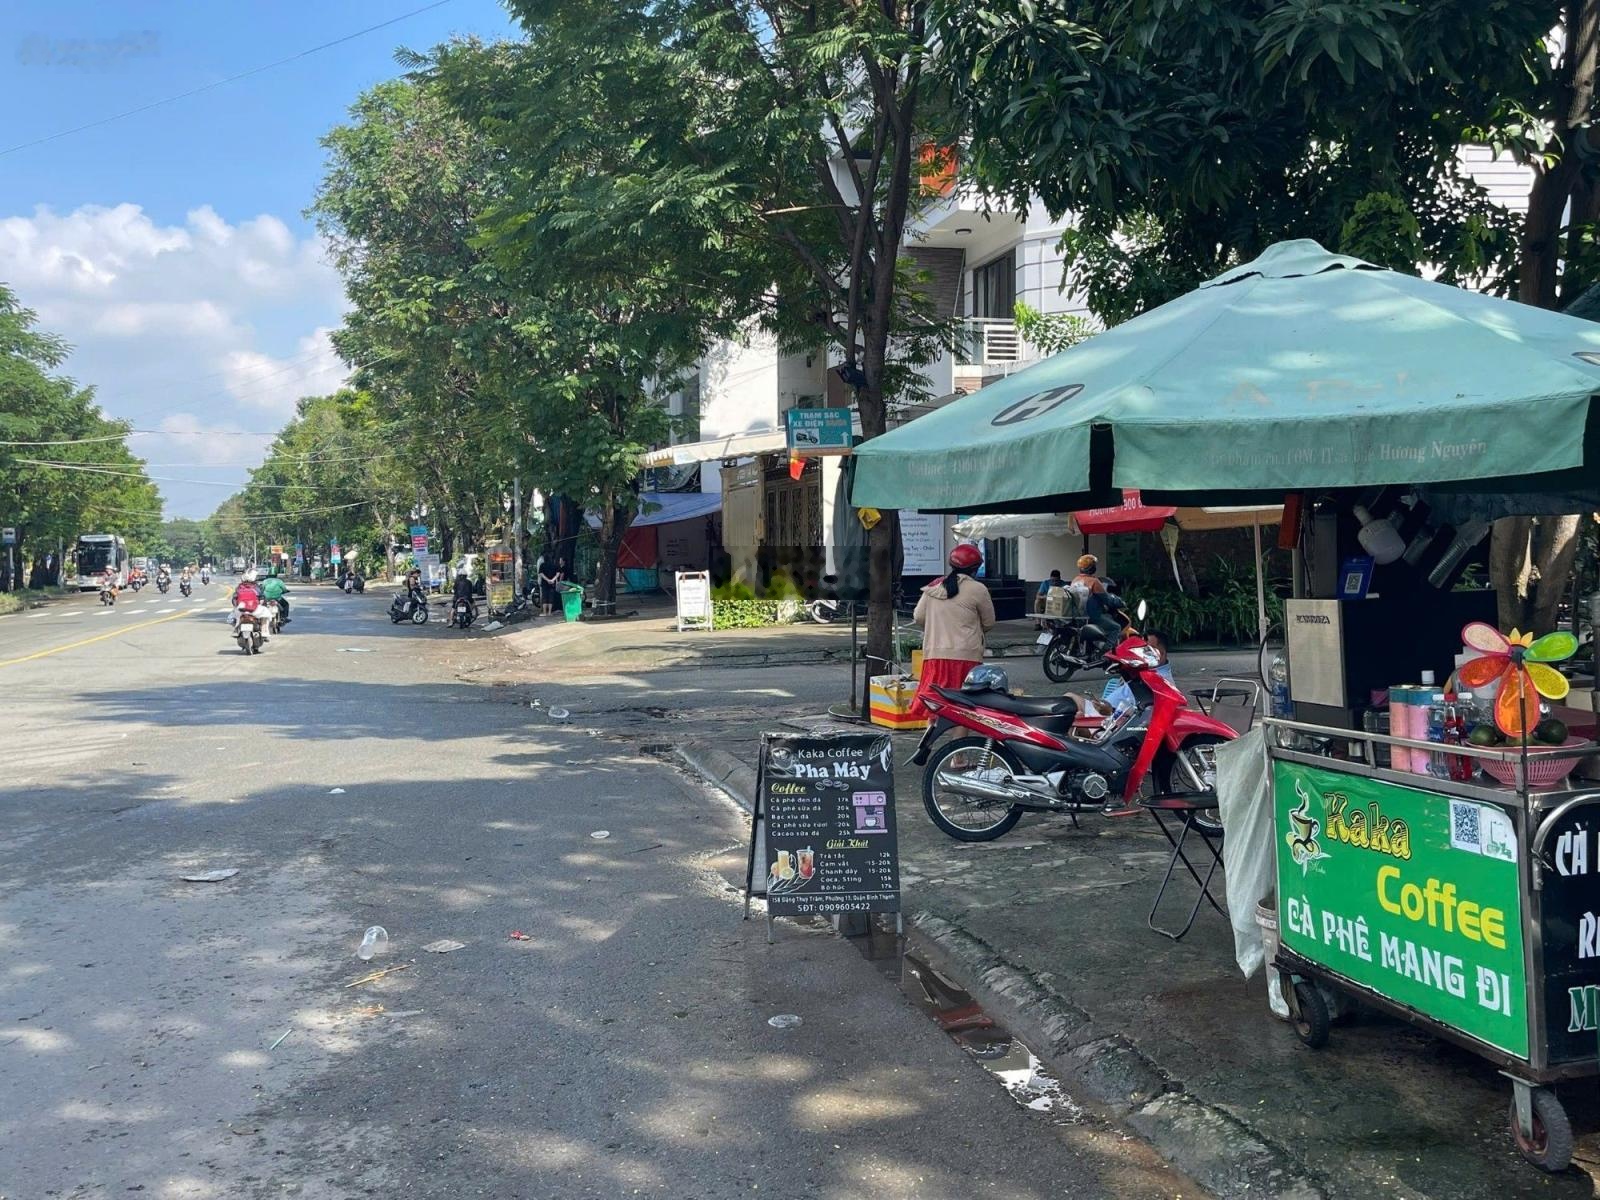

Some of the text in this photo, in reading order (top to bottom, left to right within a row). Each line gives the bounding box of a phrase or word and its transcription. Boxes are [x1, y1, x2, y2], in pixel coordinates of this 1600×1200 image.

[794, 762, 871, 780] Pha Máy
[798, 748, 863, 759] Kaka Coffee
[771, 783, 806, 794] Coffee
[1323, 792, 1412, 861] Kaka
[1555, 823, 1588, 876] CÀ
[798, 903, 870, 912] SĐT: 0909605422
[1376, 865, 1506, 950] Coffee
[1287, 895, 1512, 1017] CÀ PHÊ MANG ĐI
